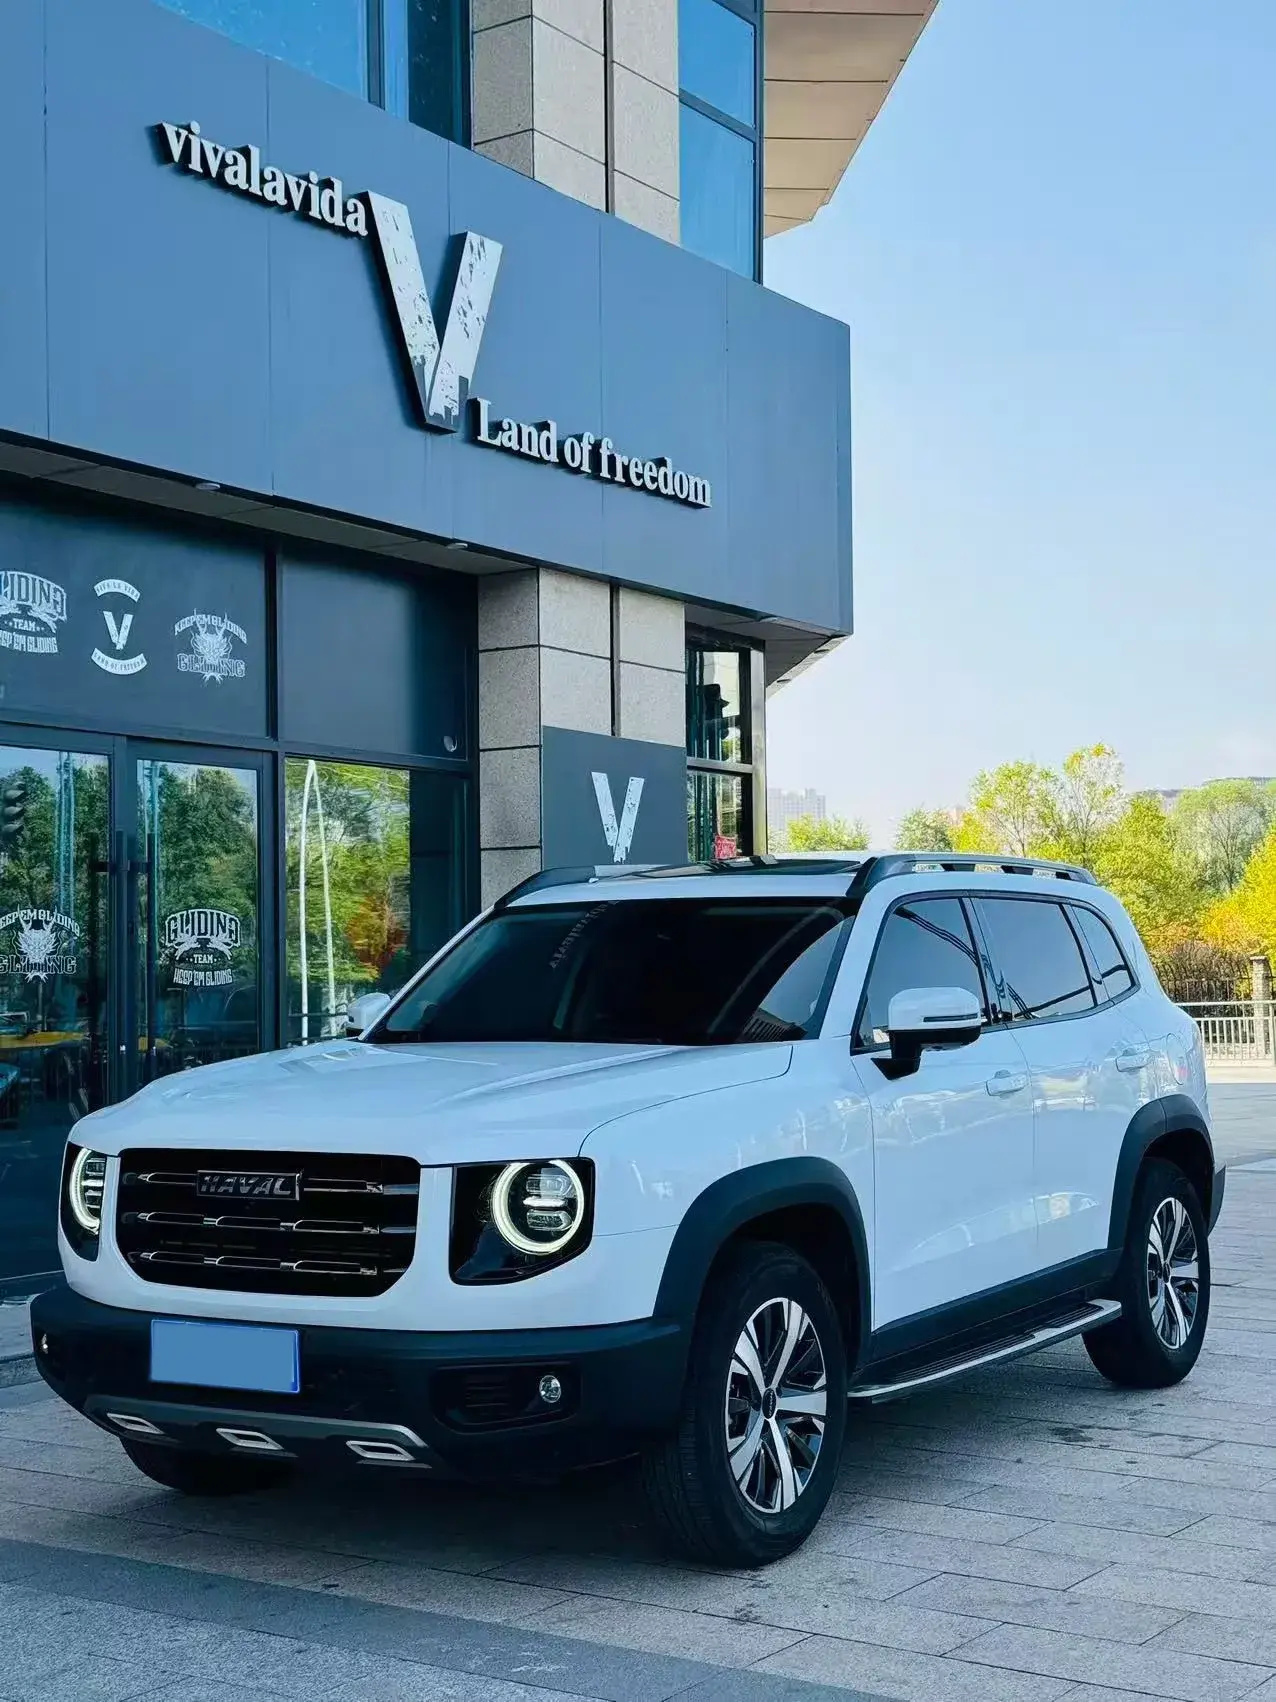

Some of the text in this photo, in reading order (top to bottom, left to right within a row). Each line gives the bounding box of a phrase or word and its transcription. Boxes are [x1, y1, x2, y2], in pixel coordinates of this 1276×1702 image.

[160, 120, 369, 237] vivalavida
[366, 190, 503, 432] V
[477, 396, 713, 509] Land of freedom
[13, 618, 36, 631] TEAM
[103, 610, 134, 650] V
[591, 771, 645, 863] V
[165, 909, 241, 947] GLIDING
[173, 967, 193, 986] KEEP
[206, 968, 233, 987] GLIDING
[193, 954, 213, 964] TEAM
[201, 1175, 291, 1195] HAVAL
